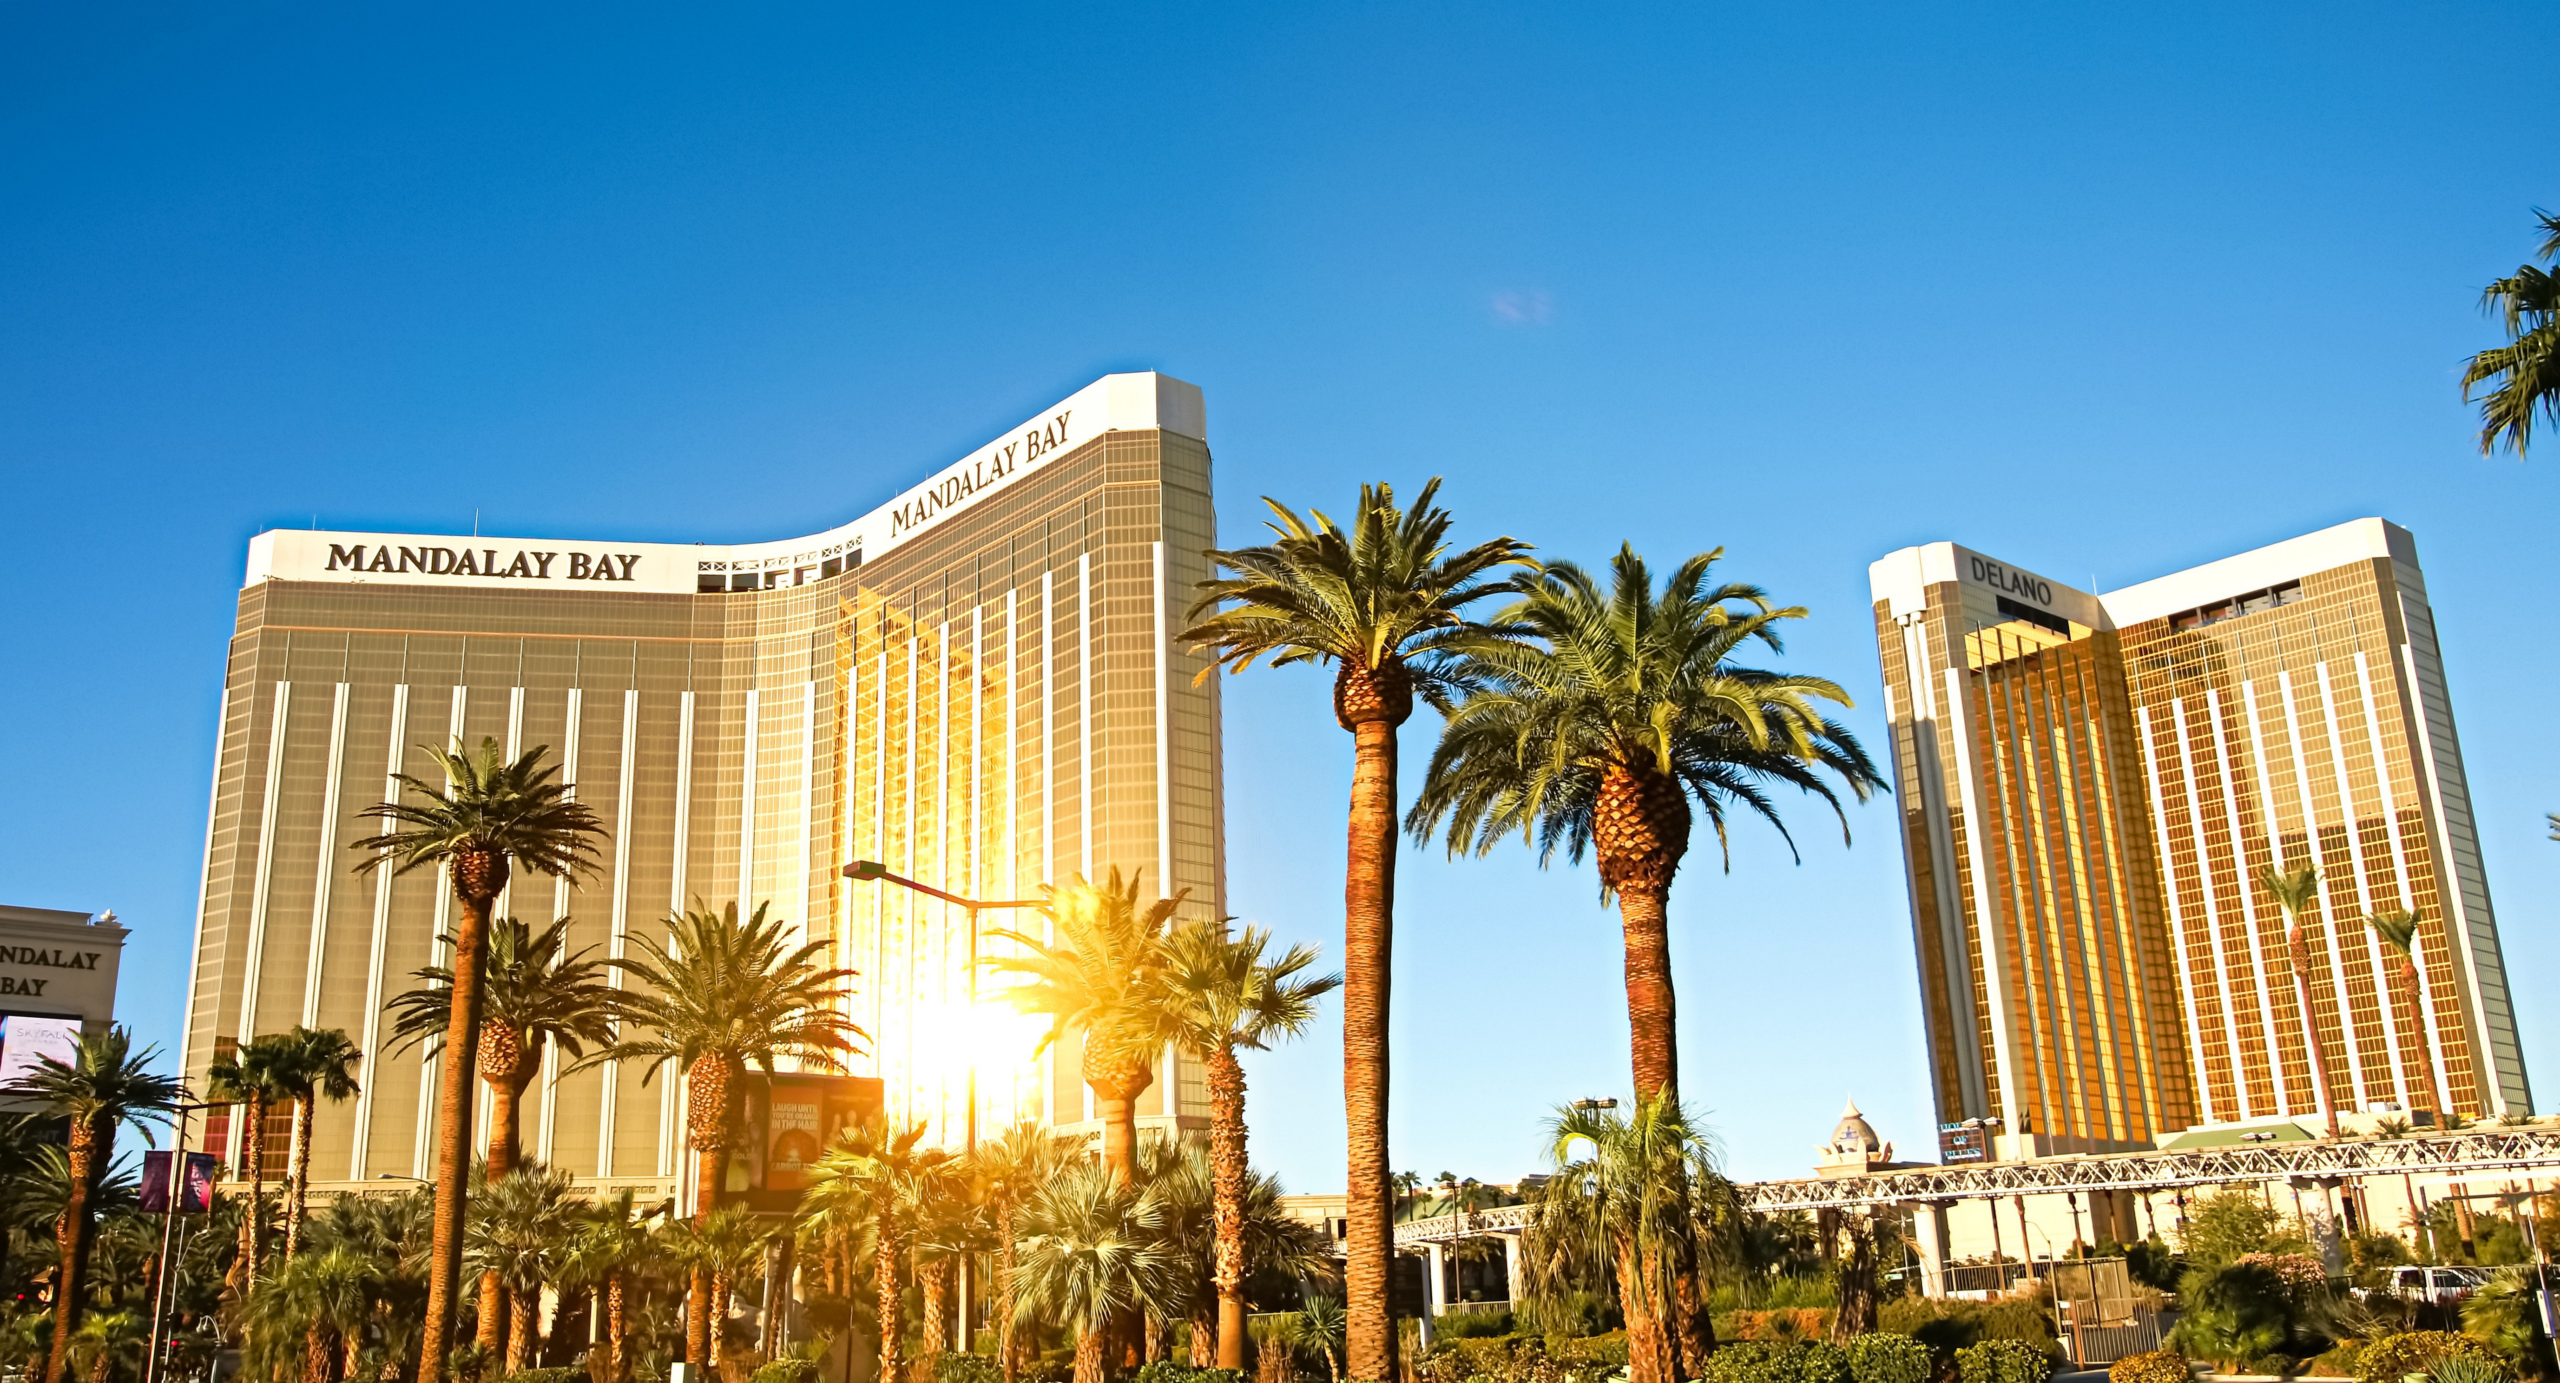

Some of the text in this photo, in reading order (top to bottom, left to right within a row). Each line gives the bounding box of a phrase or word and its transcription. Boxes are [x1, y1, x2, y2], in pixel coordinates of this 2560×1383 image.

[891, 410, 1072, 538] MANDALAY BAY
[325, 544, 642, 581] MANDALAY BAY
[1971, 556, 2052, 606] DELANO
[0, 977, 48, 996] BAY
[772, 1103, 818, 1113] LAUGH UNTIL
[772, 1120, 818, 1130] IN THE HAIR
[770, 1162, 801, 1172] CARROT
